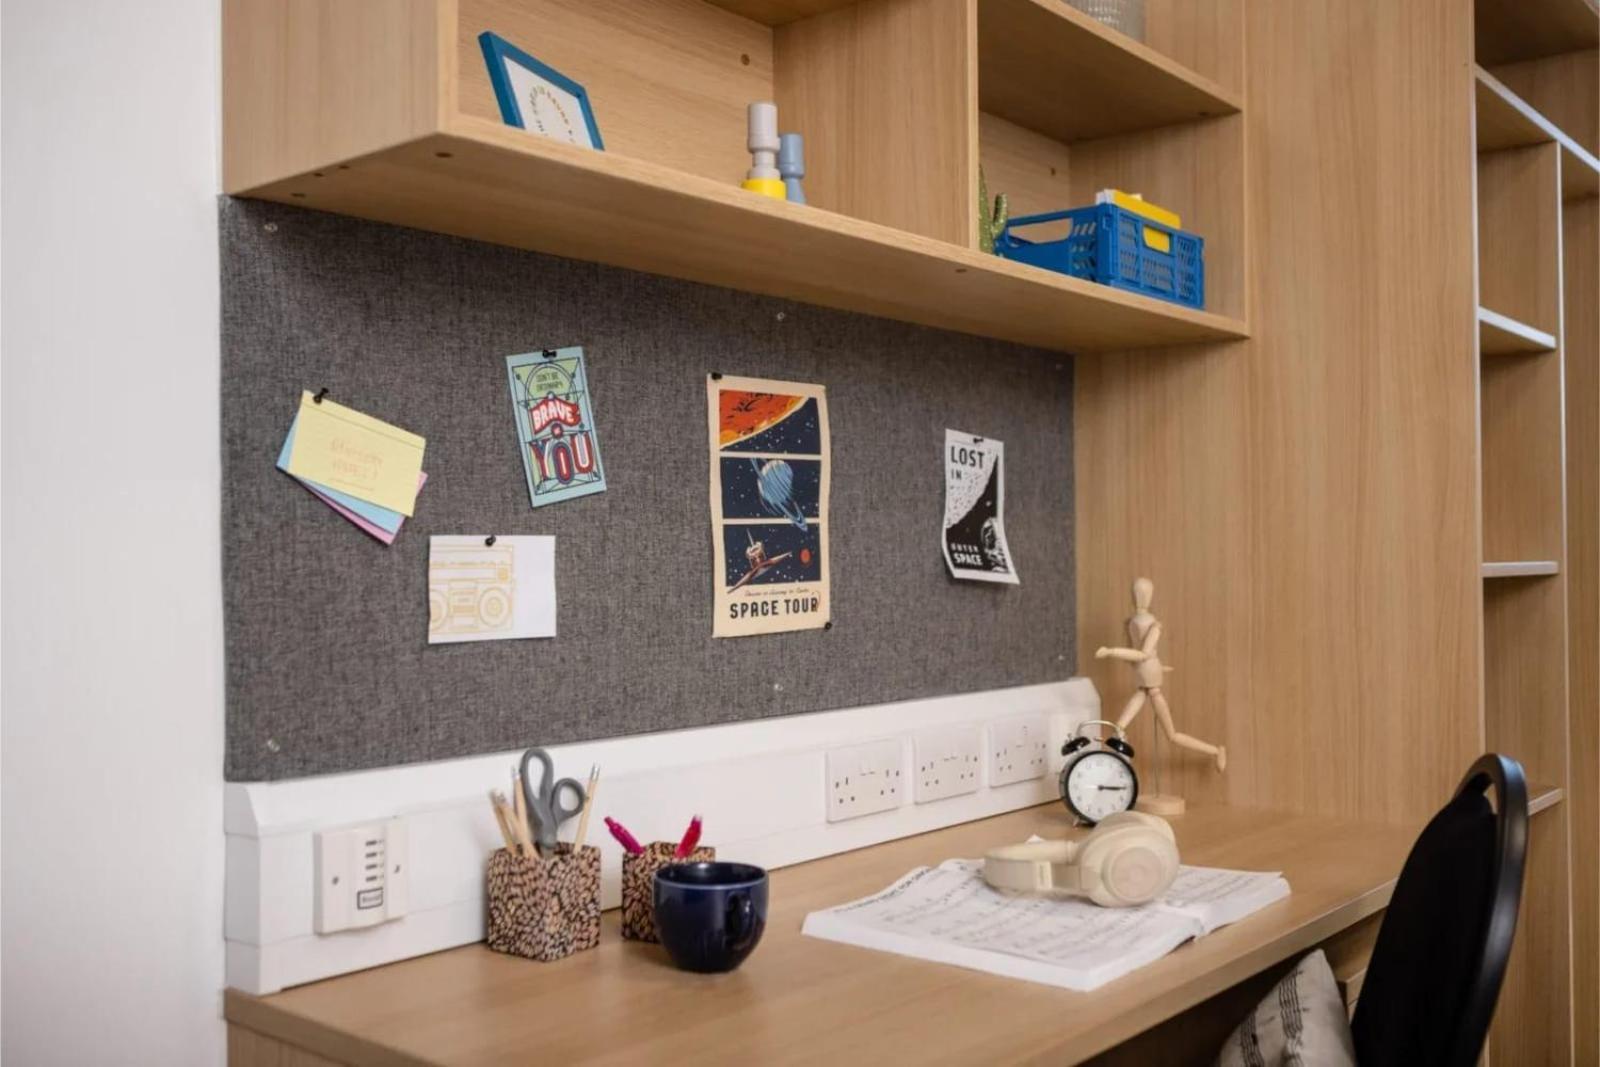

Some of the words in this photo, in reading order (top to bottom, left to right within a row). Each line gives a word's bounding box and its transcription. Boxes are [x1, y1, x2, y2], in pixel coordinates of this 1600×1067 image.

[532, 399, 577, 433] BRAVE
[530, 431, 594, 484] YOU
[951, 446, 985, 469] LOST
[951, 469, 962, 480] IN
[953, 552, 984, 566] SPACE
[729, 601, 779, 619] SPACE
[784, 597, 818, 615] TOUR
